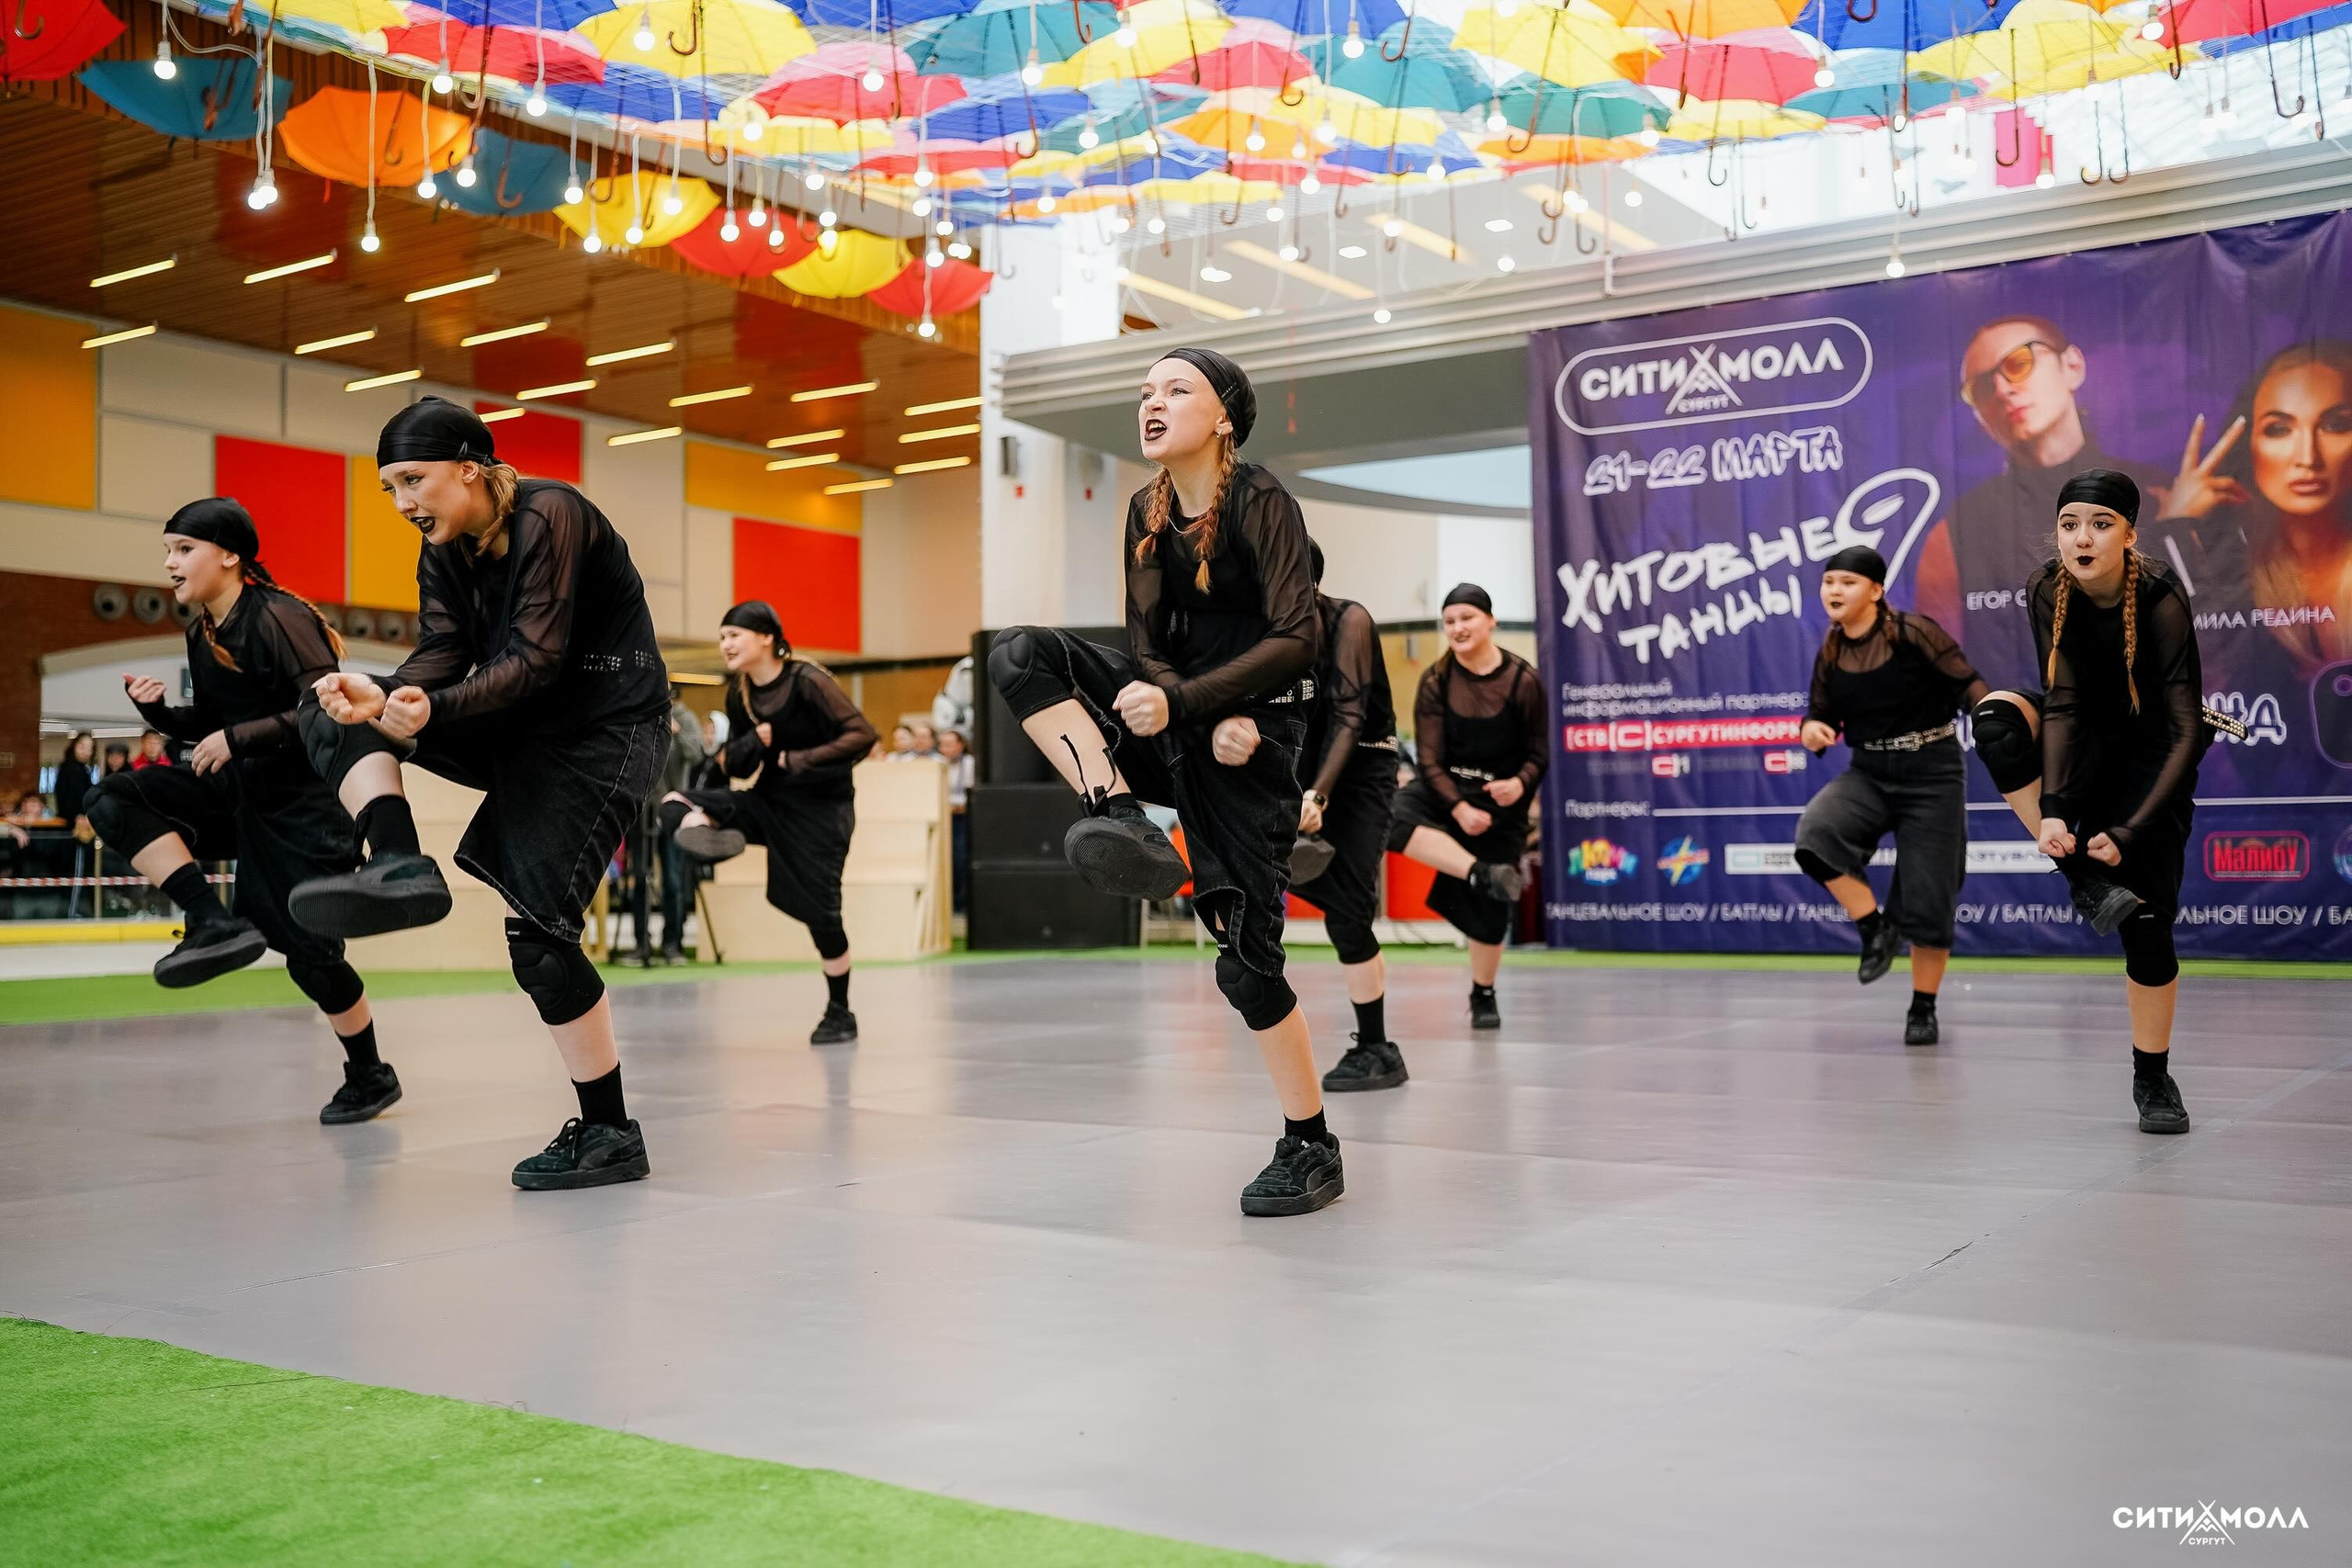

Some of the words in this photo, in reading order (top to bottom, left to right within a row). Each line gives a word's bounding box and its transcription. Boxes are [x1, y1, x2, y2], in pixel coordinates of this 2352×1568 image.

[1582, 444, 1708, 497] 21-22
[1711, 424, 1844, 483] МАРТА
[1557, 516, 1839, 634] ХИТОВЫЕ
[1618, 574, 1804, 665] ТАНЦЫ
[1966, 590, 2013, 611] ЕГОР
[2251, 604, 2336, 628] РЕДИНА
[2254, 905, 2308, 925] ШОУ
